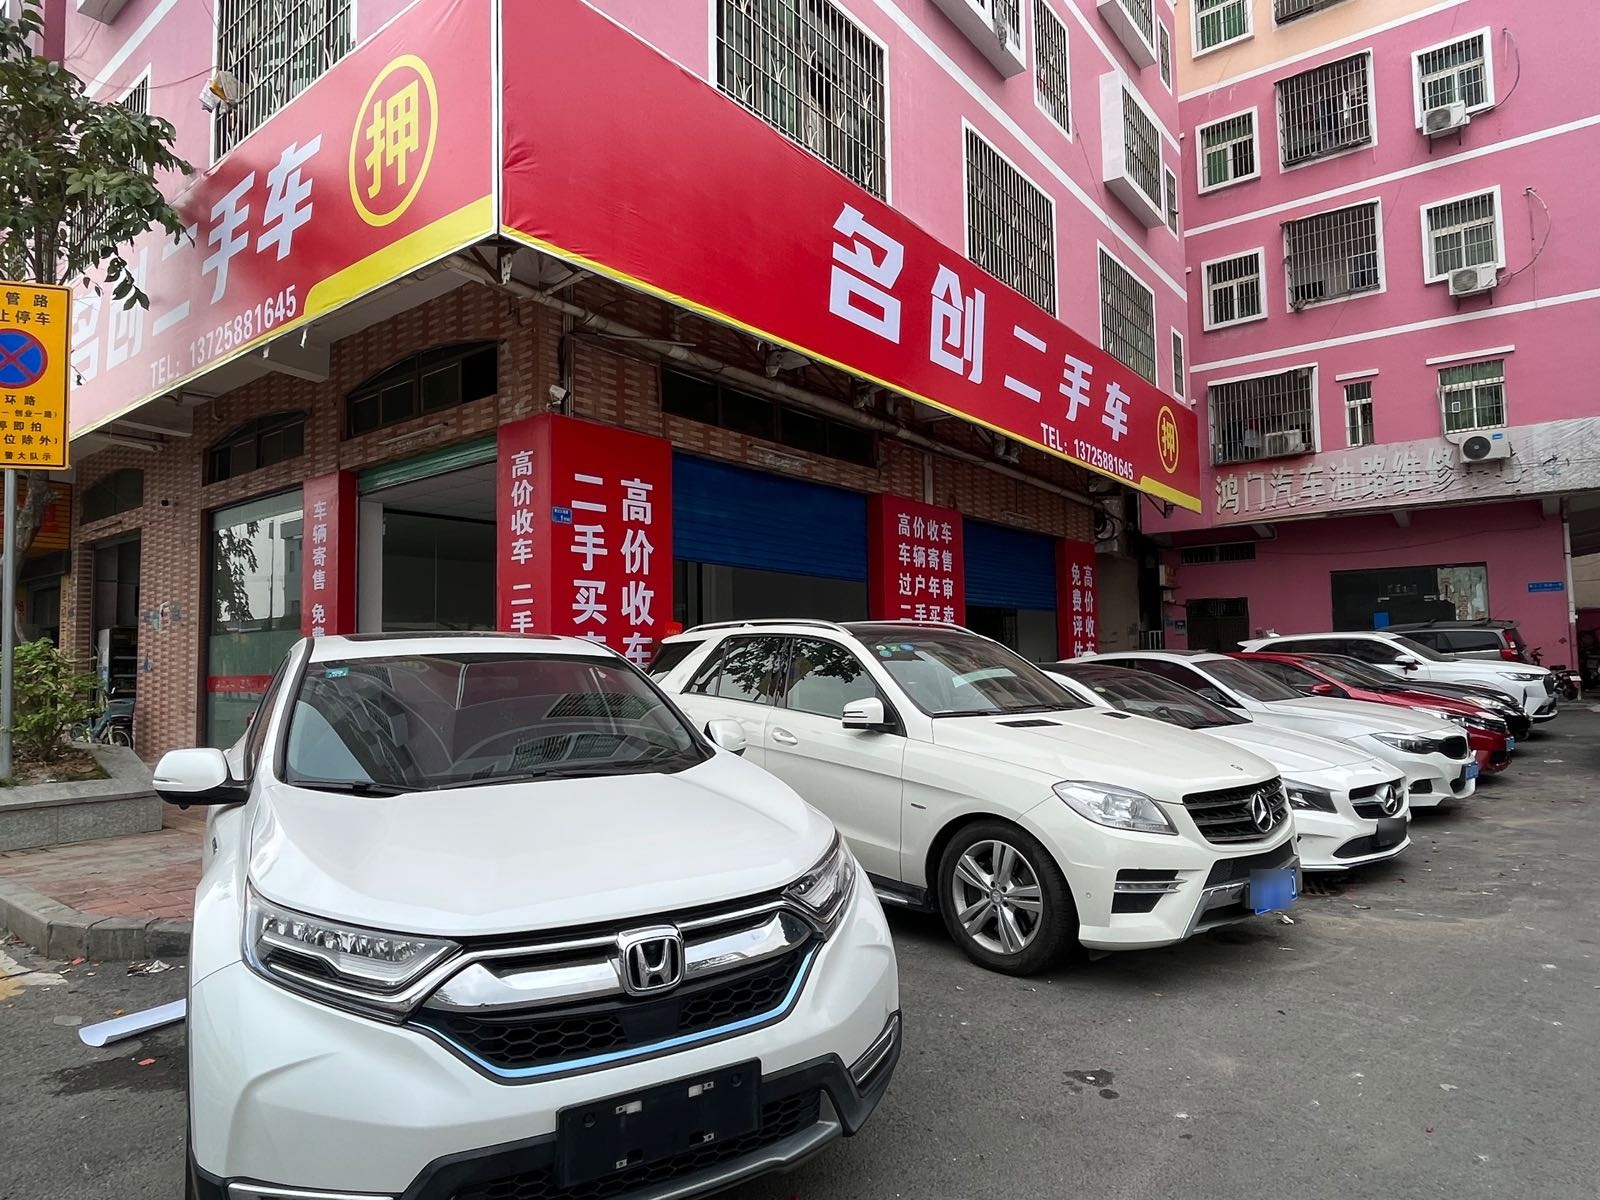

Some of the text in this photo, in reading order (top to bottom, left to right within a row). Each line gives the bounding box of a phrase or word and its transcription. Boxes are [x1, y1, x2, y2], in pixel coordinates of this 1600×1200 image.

[364, 79, 420, 200] 押
[190, 284, 297, 367] 13725881645
[829, 202, 1131, 442] 名创二手车
[1074, 438, 1134, 481] 13725881645
[1161, 416, 1175, 462] 押
[312, 500, 328, 591] 车辆寄售
[511, 450, 534, 565] 高价收车
[897, 512, 953, 544] 高价收车
[620, 478, 655, 668] 高价收车
[898, 542, 953, 573] 车辆寄售
[898, 572, 954, 600] 过户年审
